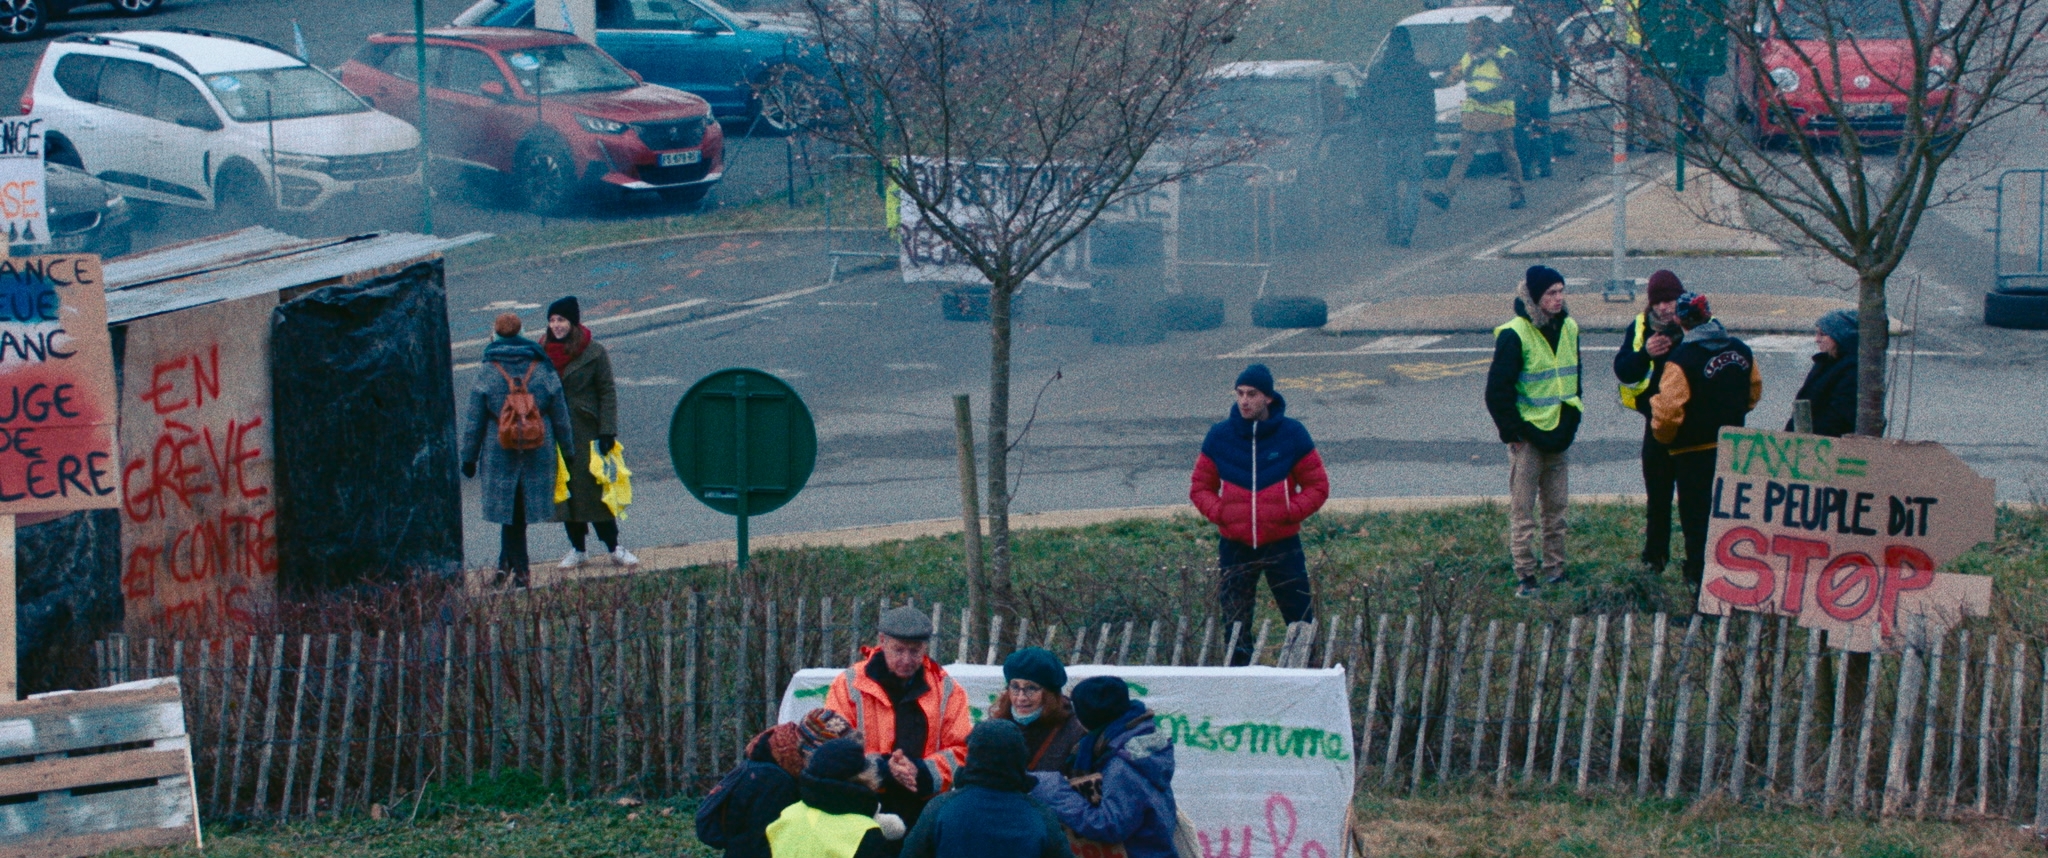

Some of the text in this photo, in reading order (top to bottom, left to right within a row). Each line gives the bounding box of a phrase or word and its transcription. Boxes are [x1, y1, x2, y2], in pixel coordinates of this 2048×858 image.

[0, 118, 43, 155] NCE
[0, 180, 40, 220] SE
[0, 328, 78, 361] ANC
[139, 343, 220, 414] EN
[122, 416, 268, 523] GRÈVE
[1712, 476, 1753, 519] LE
[1764, 480, 1877, 536] PEUPLE
[122, 509, 279, 600] ET CONTRE
